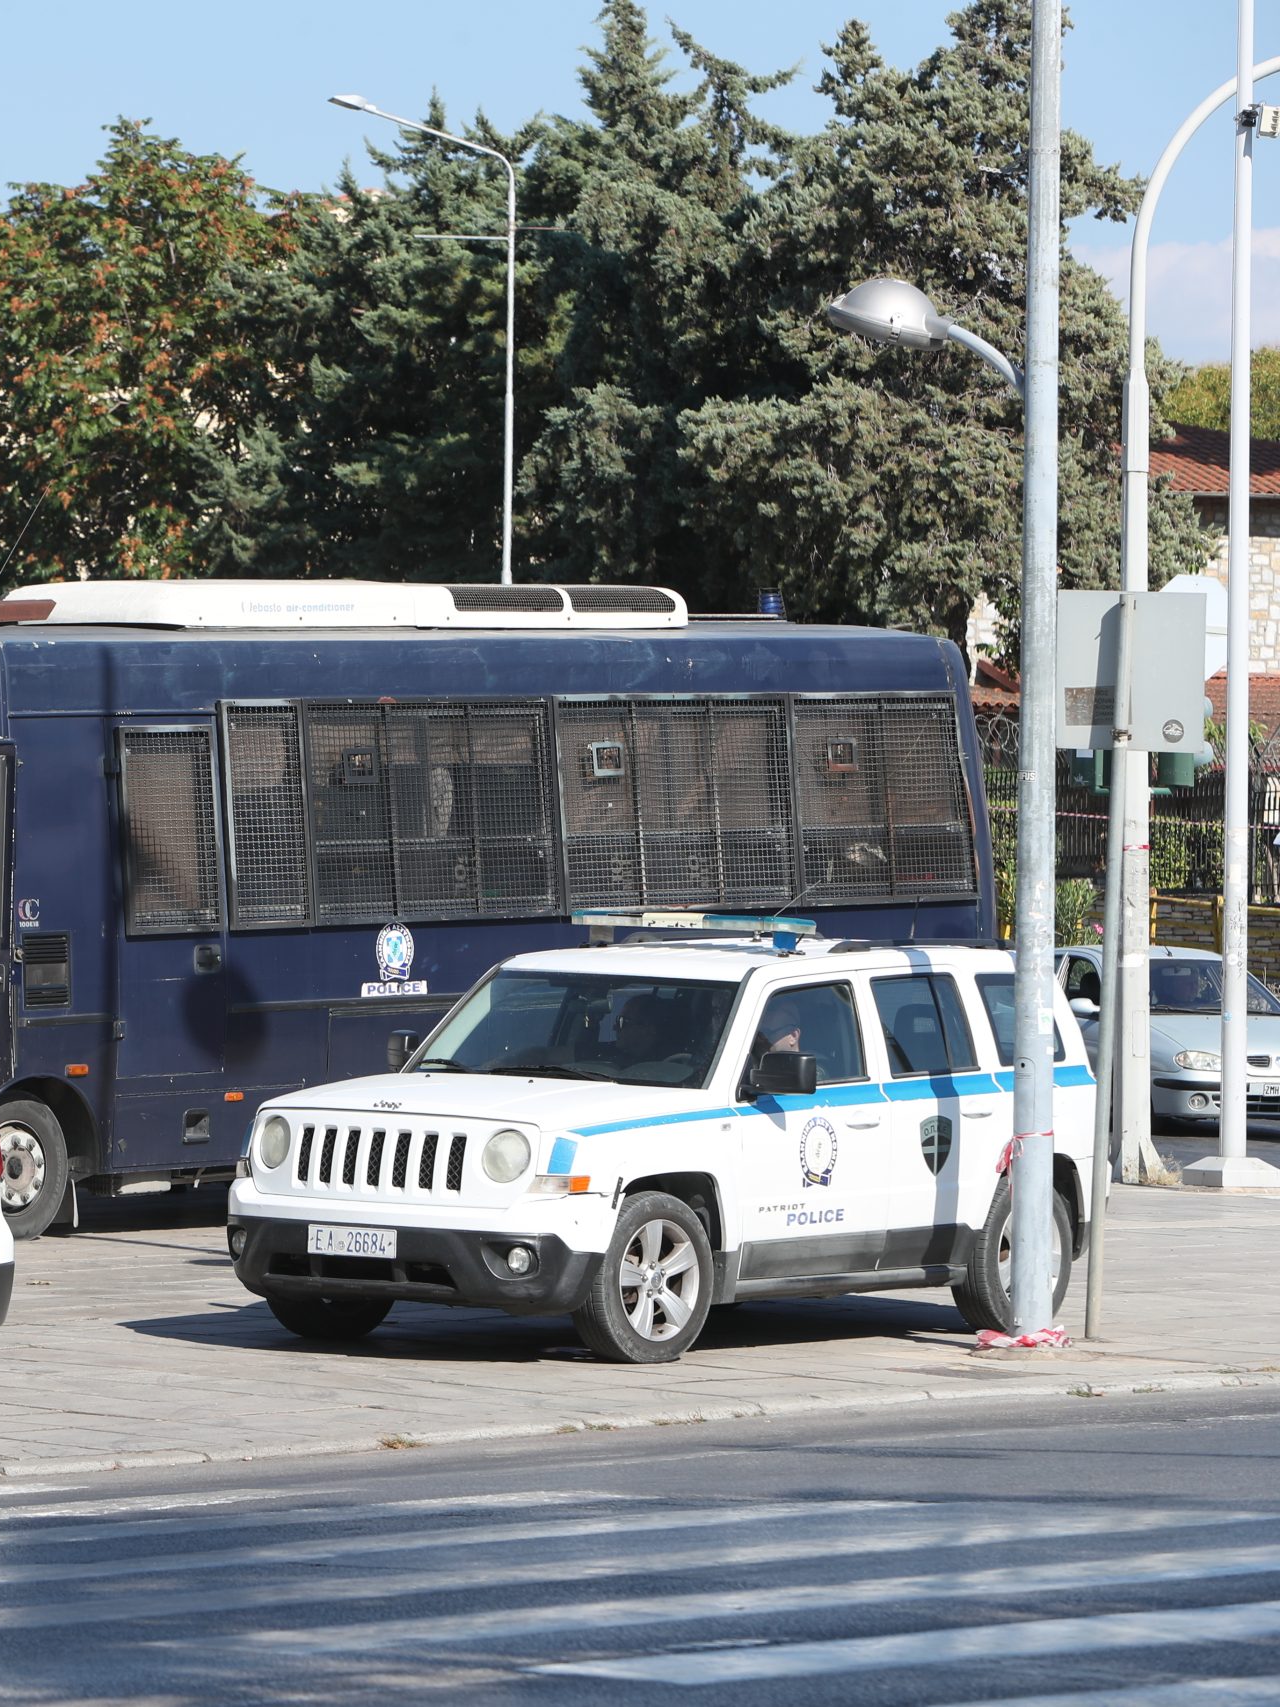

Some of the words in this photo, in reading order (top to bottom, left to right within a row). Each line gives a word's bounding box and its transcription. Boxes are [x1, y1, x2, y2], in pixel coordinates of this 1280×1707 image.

[286, 603, 355, 613] air-conditioner
[758, 1202, 807, 1213] PATRIOT
[786, 1208, 845, 1226] POLICE
[347, 1231, 386, 1254] 26684
